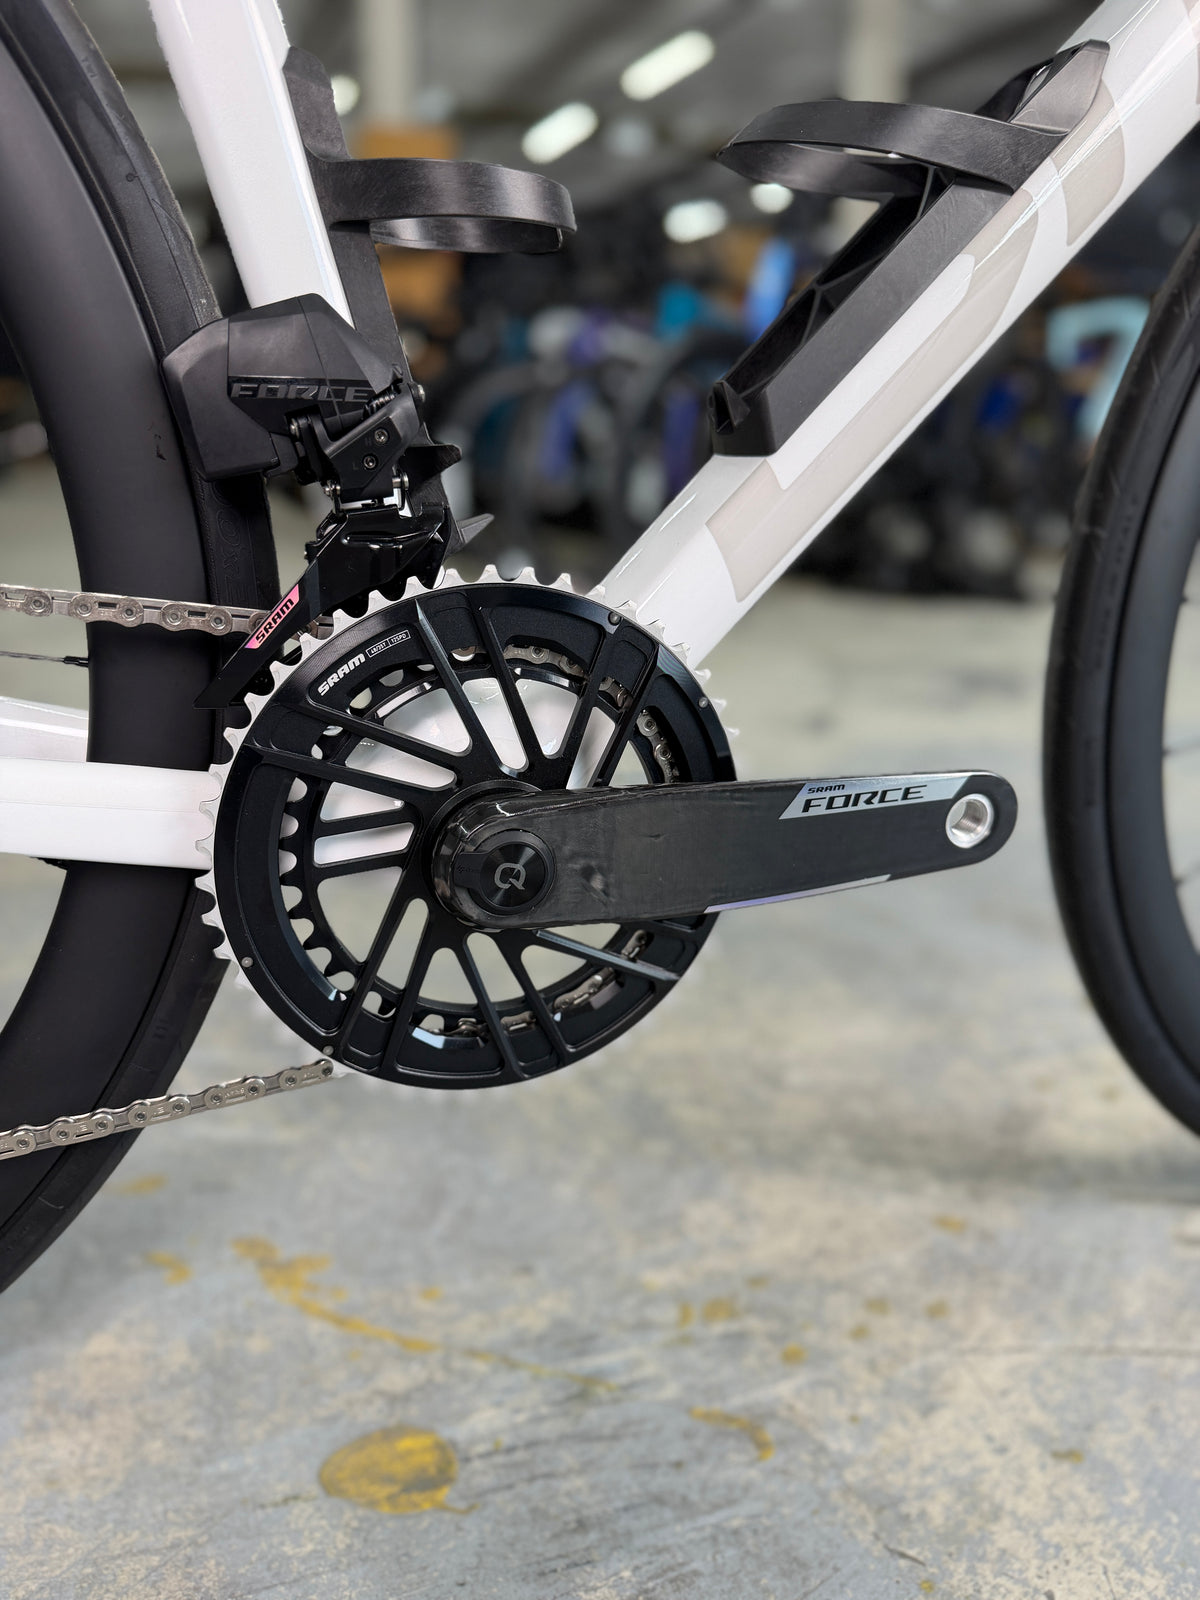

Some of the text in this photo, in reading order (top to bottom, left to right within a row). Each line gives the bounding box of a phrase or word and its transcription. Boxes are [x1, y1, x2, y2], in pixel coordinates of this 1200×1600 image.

[231, 383, 376, 403] FORCE
[255, 598, 295, 644] SRAM
[317, 653, 366, 696] SRAM
[801, 784, 928, 813] FORCE
[807, 784, 846, 794] SRAM
[494, 862, 526, 890] Q
